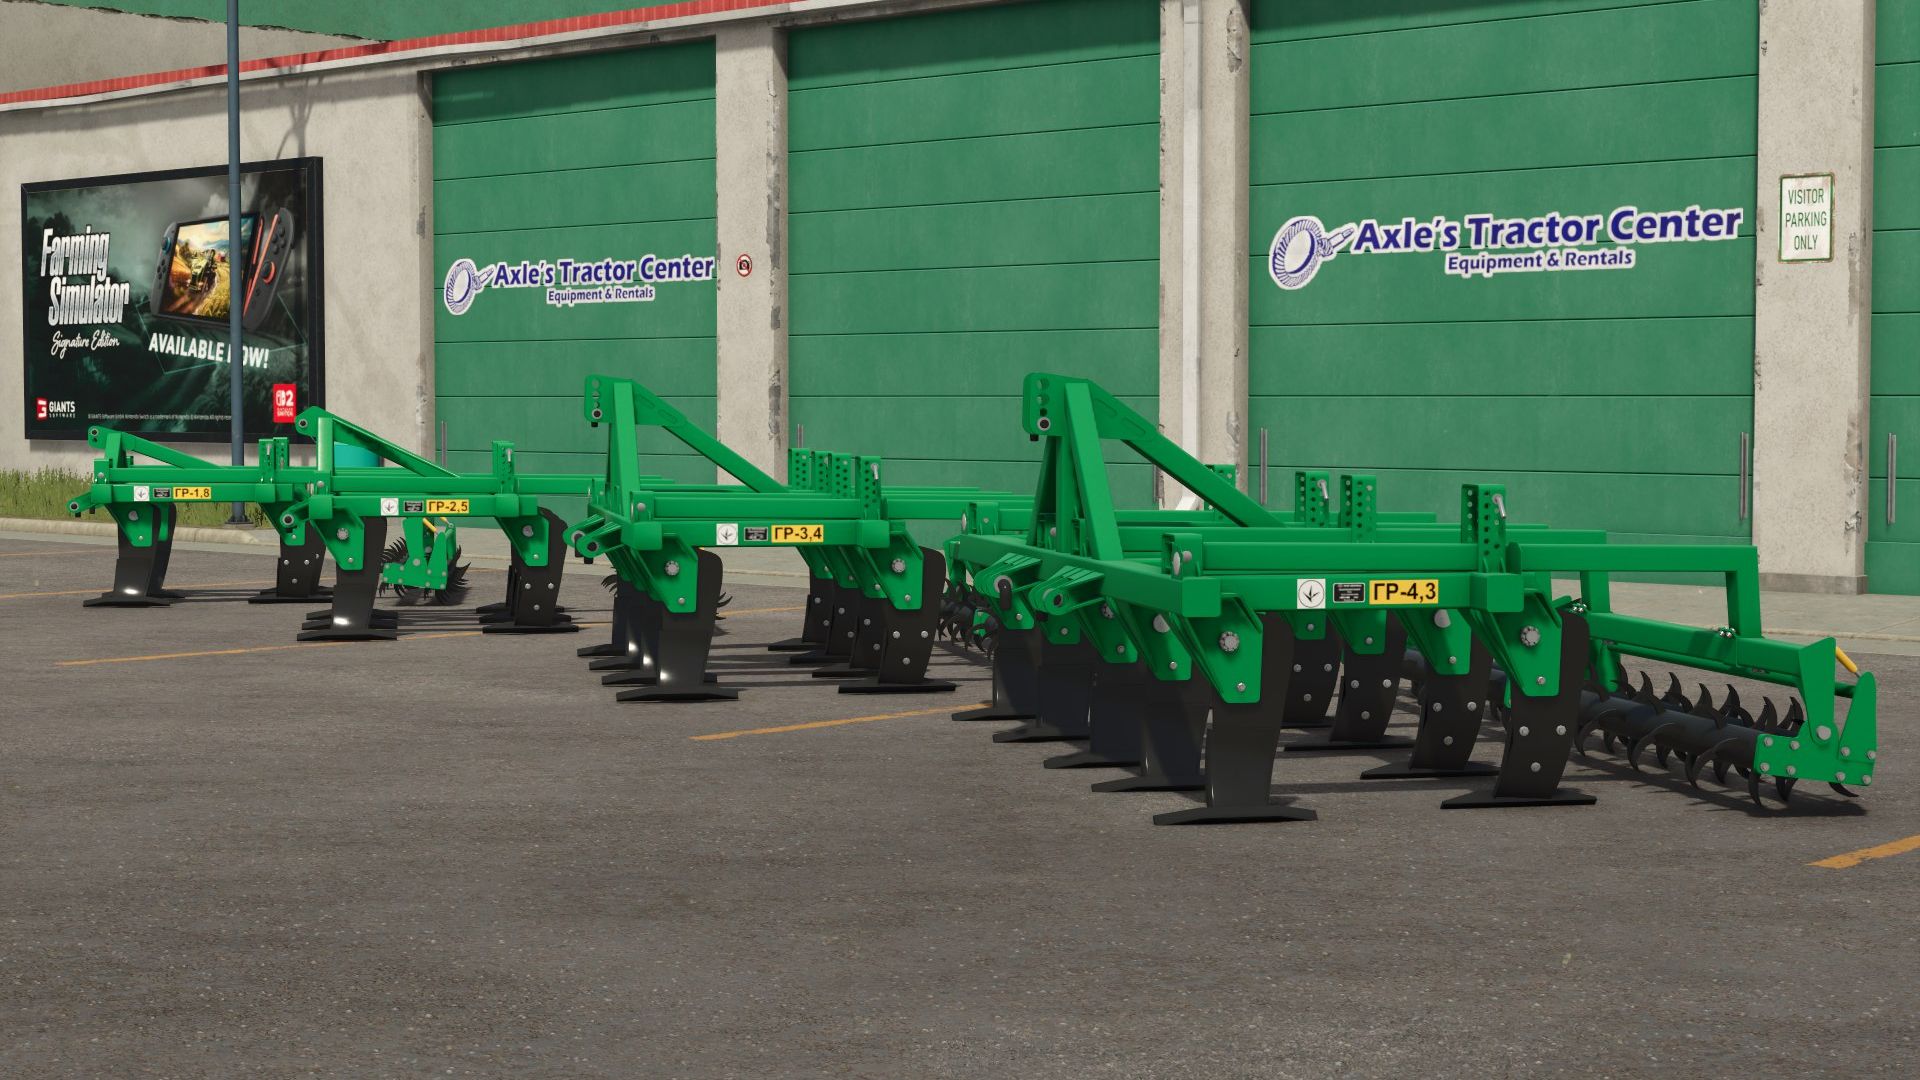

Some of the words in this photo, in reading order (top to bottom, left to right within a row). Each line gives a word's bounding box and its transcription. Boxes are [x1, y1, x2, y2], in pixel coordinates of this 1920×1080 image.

[1787, 188, 1825, 205] VISITOR
[1353, 219, 1457, 250] Axle's
[1467, 216, 1600, 247] Tractor
[1611, 209, 1742, 240] Center
[1785, 211, 1827, 228] PARKING
[1793, 234, 1818, 251] ONLY
[41, 225, 110, 282] Farming
[1448, 254, 1542, 274] Equipment
[1547, 253, 1559, 267] &
[1565, 249, 1632, 267] Rentals
[494, 262, 554, 286] Axle's
[559, 260, 635, 284] Tractor
[640, 256, 714, 280] Center
[48, 275, 130, 326] Simulator
[548, 288, 603, 304] Equipment
[605, 288, 612, 299] &
[615, 286, 654, 300] Rentals
[51, 330, 90, 359] Signature
[91, 329, 120, 350] Edition
[148, 332, 225, 362] AVAILABLE
[49, 400, 76, 413] GIANTS
[428, 501, 468, 513] ГР-2,5
[774, 526, 822, 542] ГР-3,4
[1374, 582, 1436, 603] ГР-4,3
